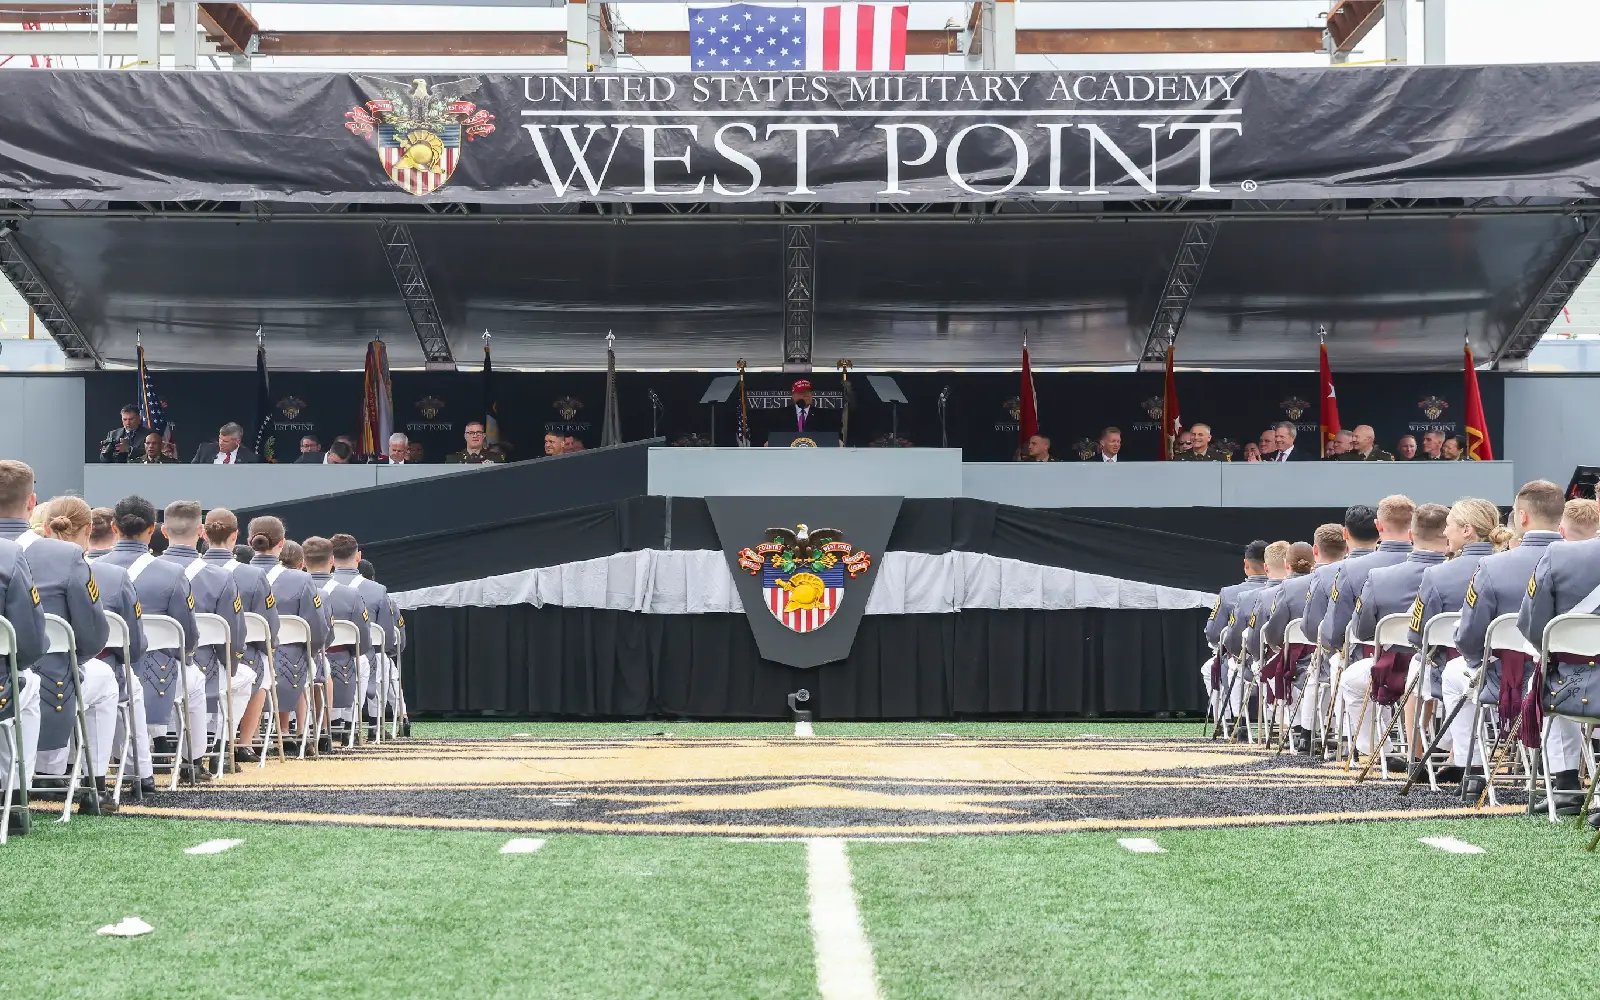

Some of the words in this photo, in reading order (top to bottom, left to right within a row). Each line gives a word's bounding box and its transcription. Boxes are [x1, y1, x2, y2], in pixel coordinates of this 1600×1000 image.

[521, 76, 676, 102] UNITED
[693, 76, 828, 102] STATES
[847, 75, 1030, 102] MILITARY
[1046, 75, 1242, 102] ACADEMY
[521, 122, 840, 198] WEST
[874, 122, 1242, 195] POINT
[747, 397, 792, 409] WEST
